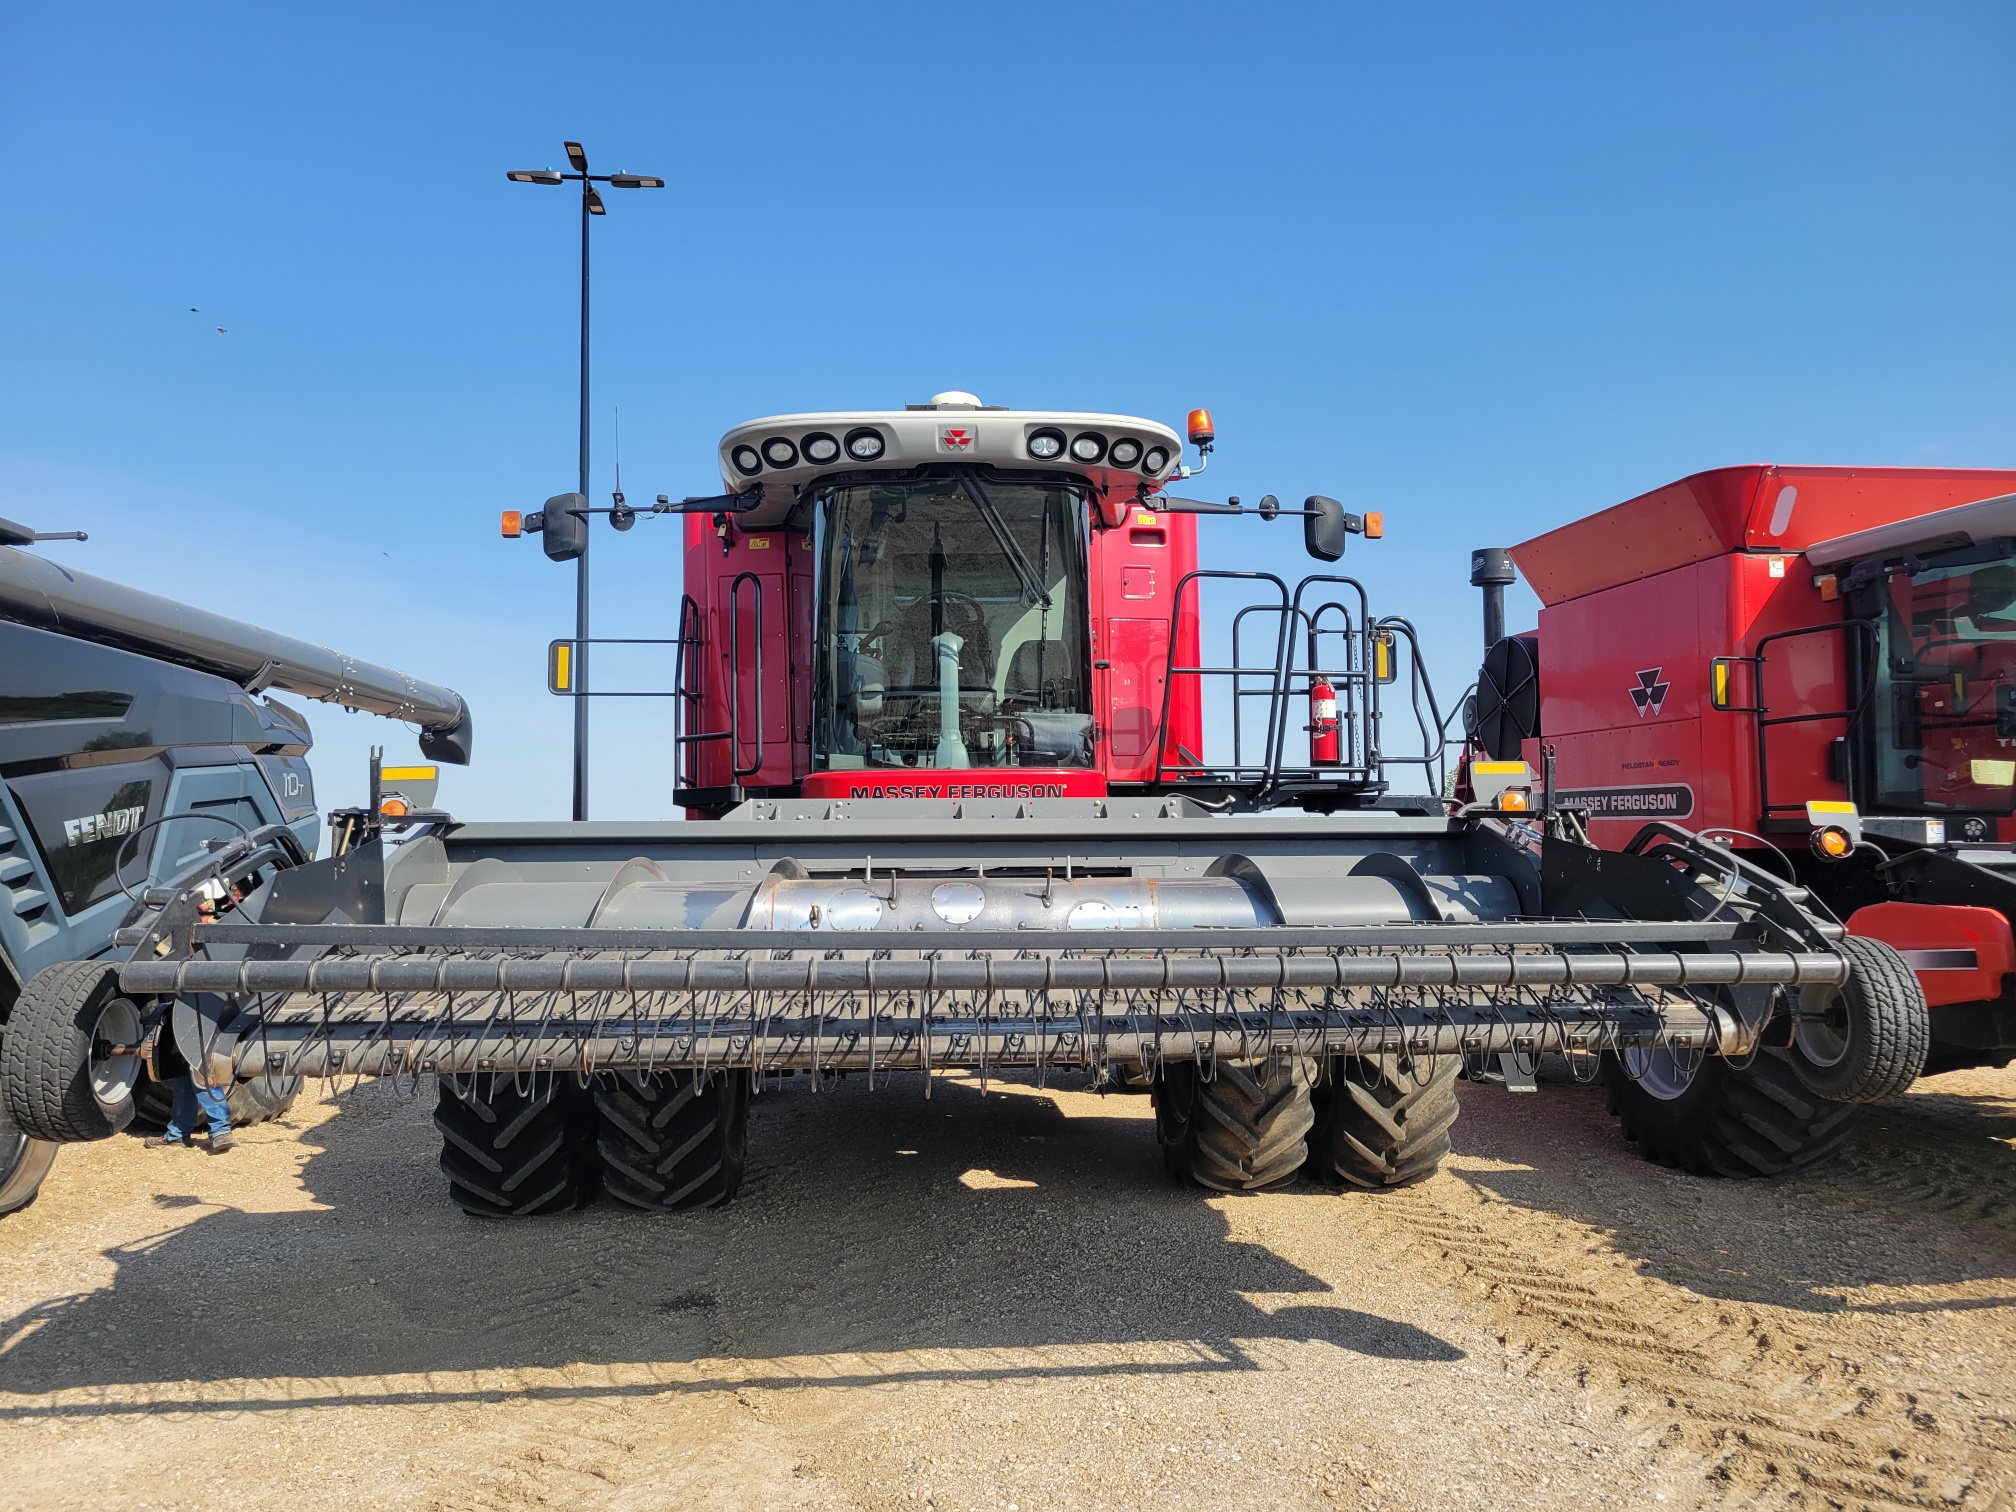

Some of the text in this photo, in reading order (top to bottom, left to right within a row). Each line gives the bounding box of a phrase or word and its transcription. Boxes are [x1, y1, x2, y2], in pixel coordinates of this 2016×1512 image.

[1621, 761, 1654, 770] FIELDSTAR
[850, 784, 1063, 799] MASSEY FERGUSON
[1611, 793, 1677, 811] FERGUSON
[63, 805, 144, 847] FENDT
